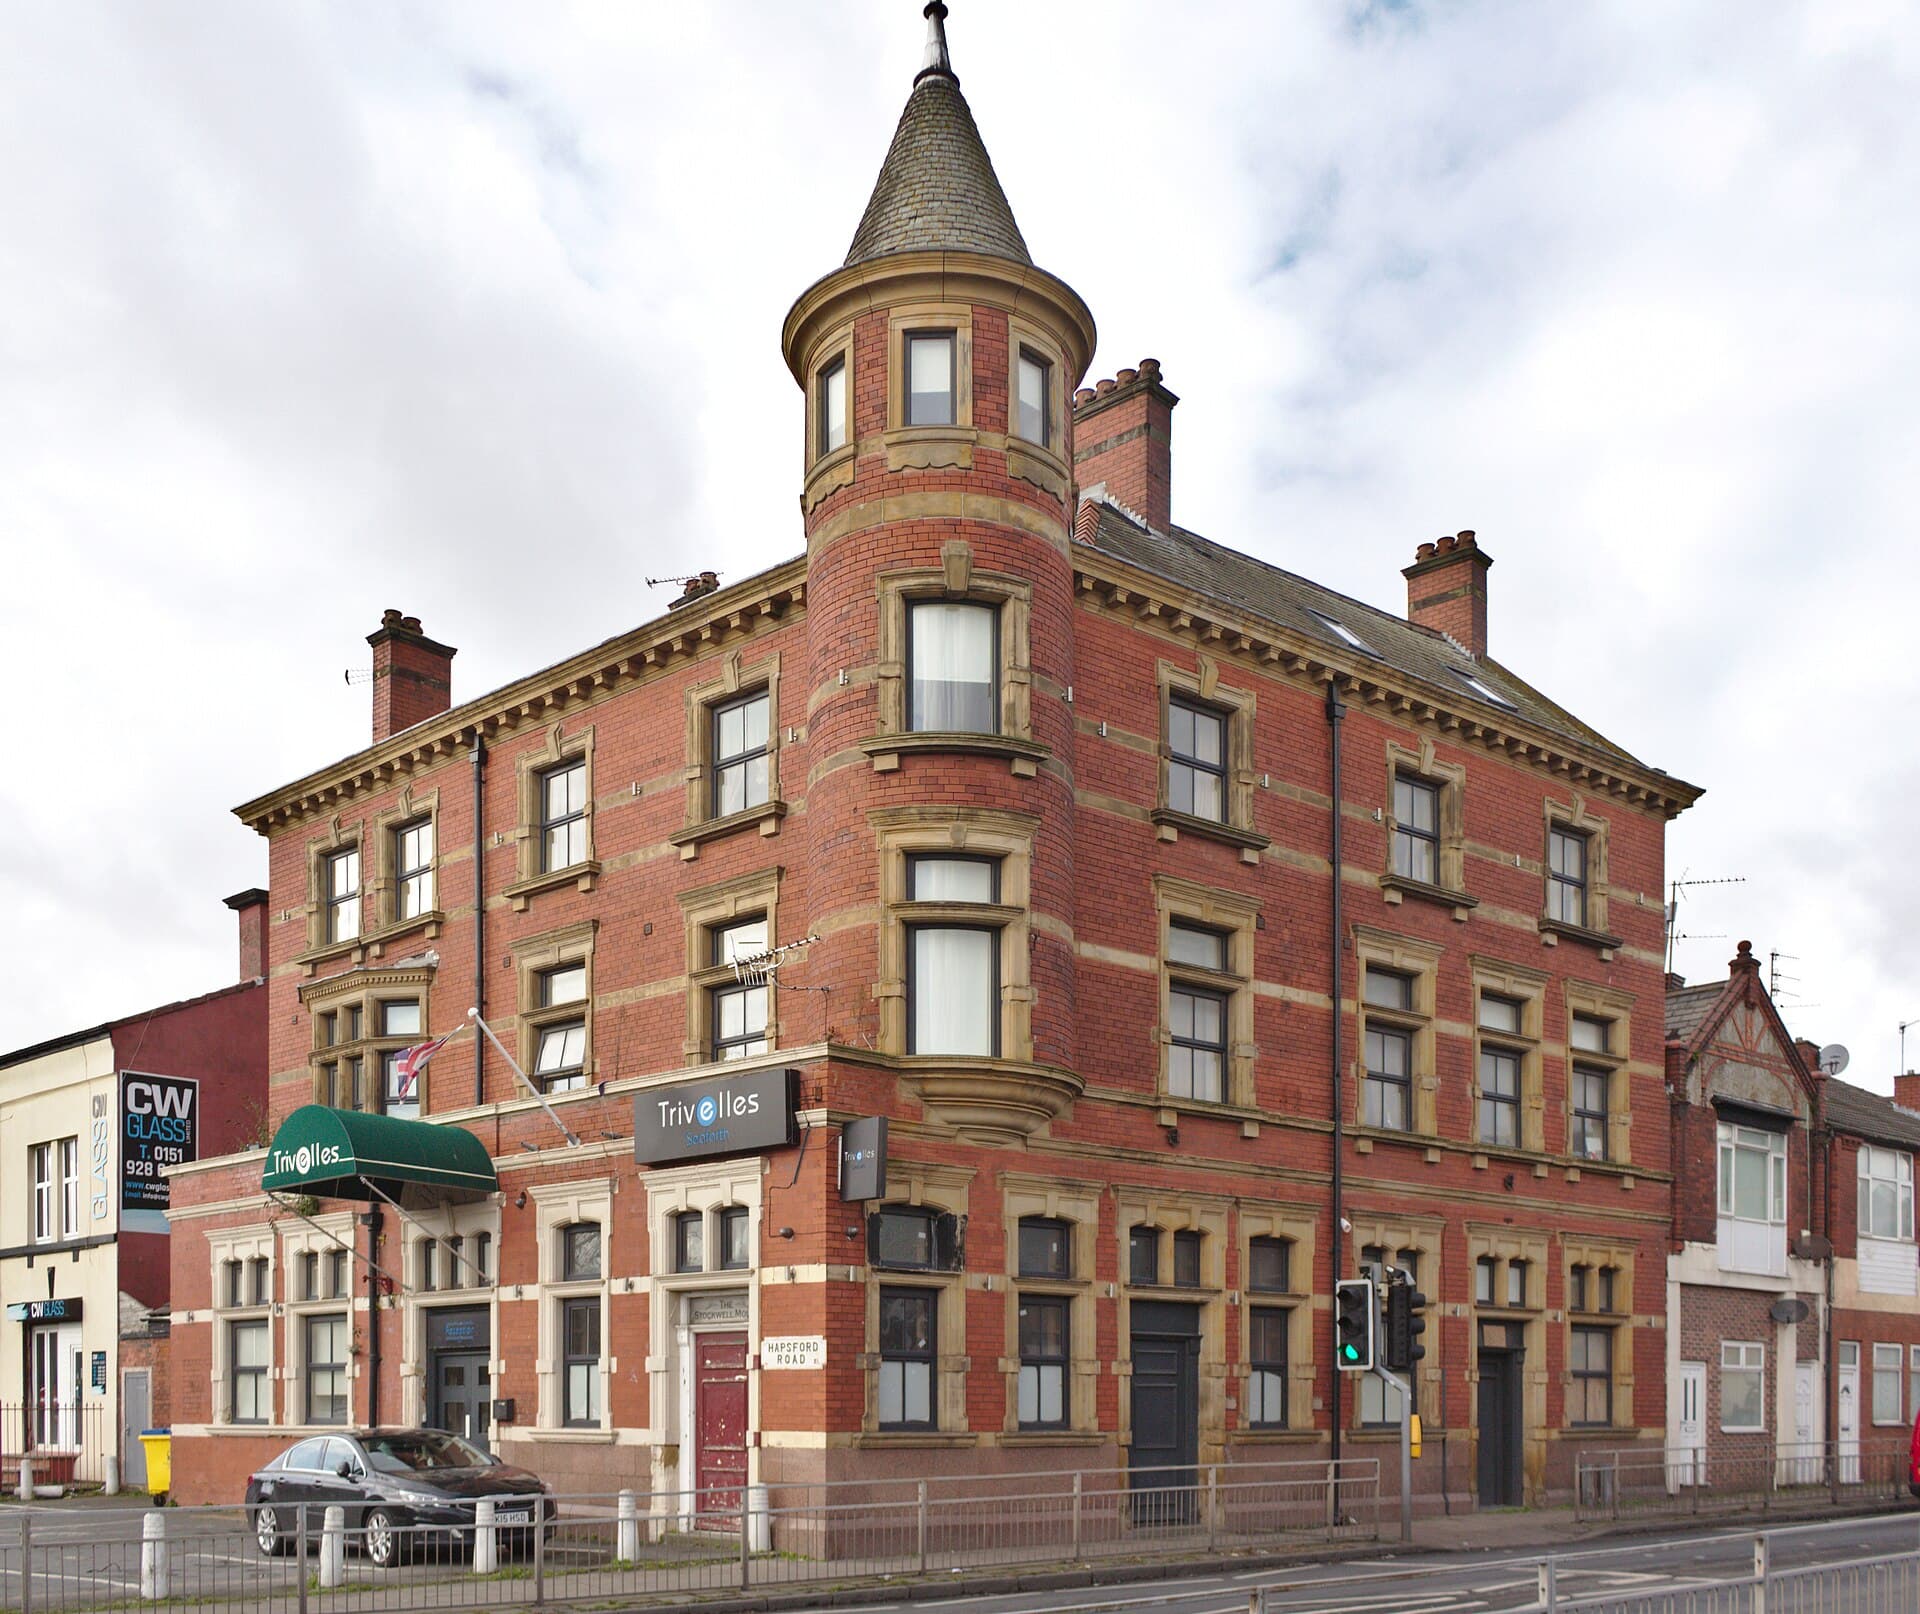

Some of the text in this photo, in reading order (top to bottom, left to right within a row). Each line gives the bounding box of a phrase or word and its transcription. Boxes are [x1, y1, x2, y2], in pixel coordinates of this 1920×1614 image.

[127, 1082, 193, 1119] CW
[658, 1090, 760, 1128] Trivelles
[127, 1113, 186, 1143] GLASS
[139, 1144, 183, 1163] T. 0151
[273, 1142, 340, 1175] Trivelles
[92, 1118, 108, 1220] GLASS
[126, 1159, 153, 1177] 928
[31, 1300, 65, 1318] CW GLASS
[768, 1341, 819, 1353] HAPSFORD
[777, 1354, 806, 1364] ROAD
